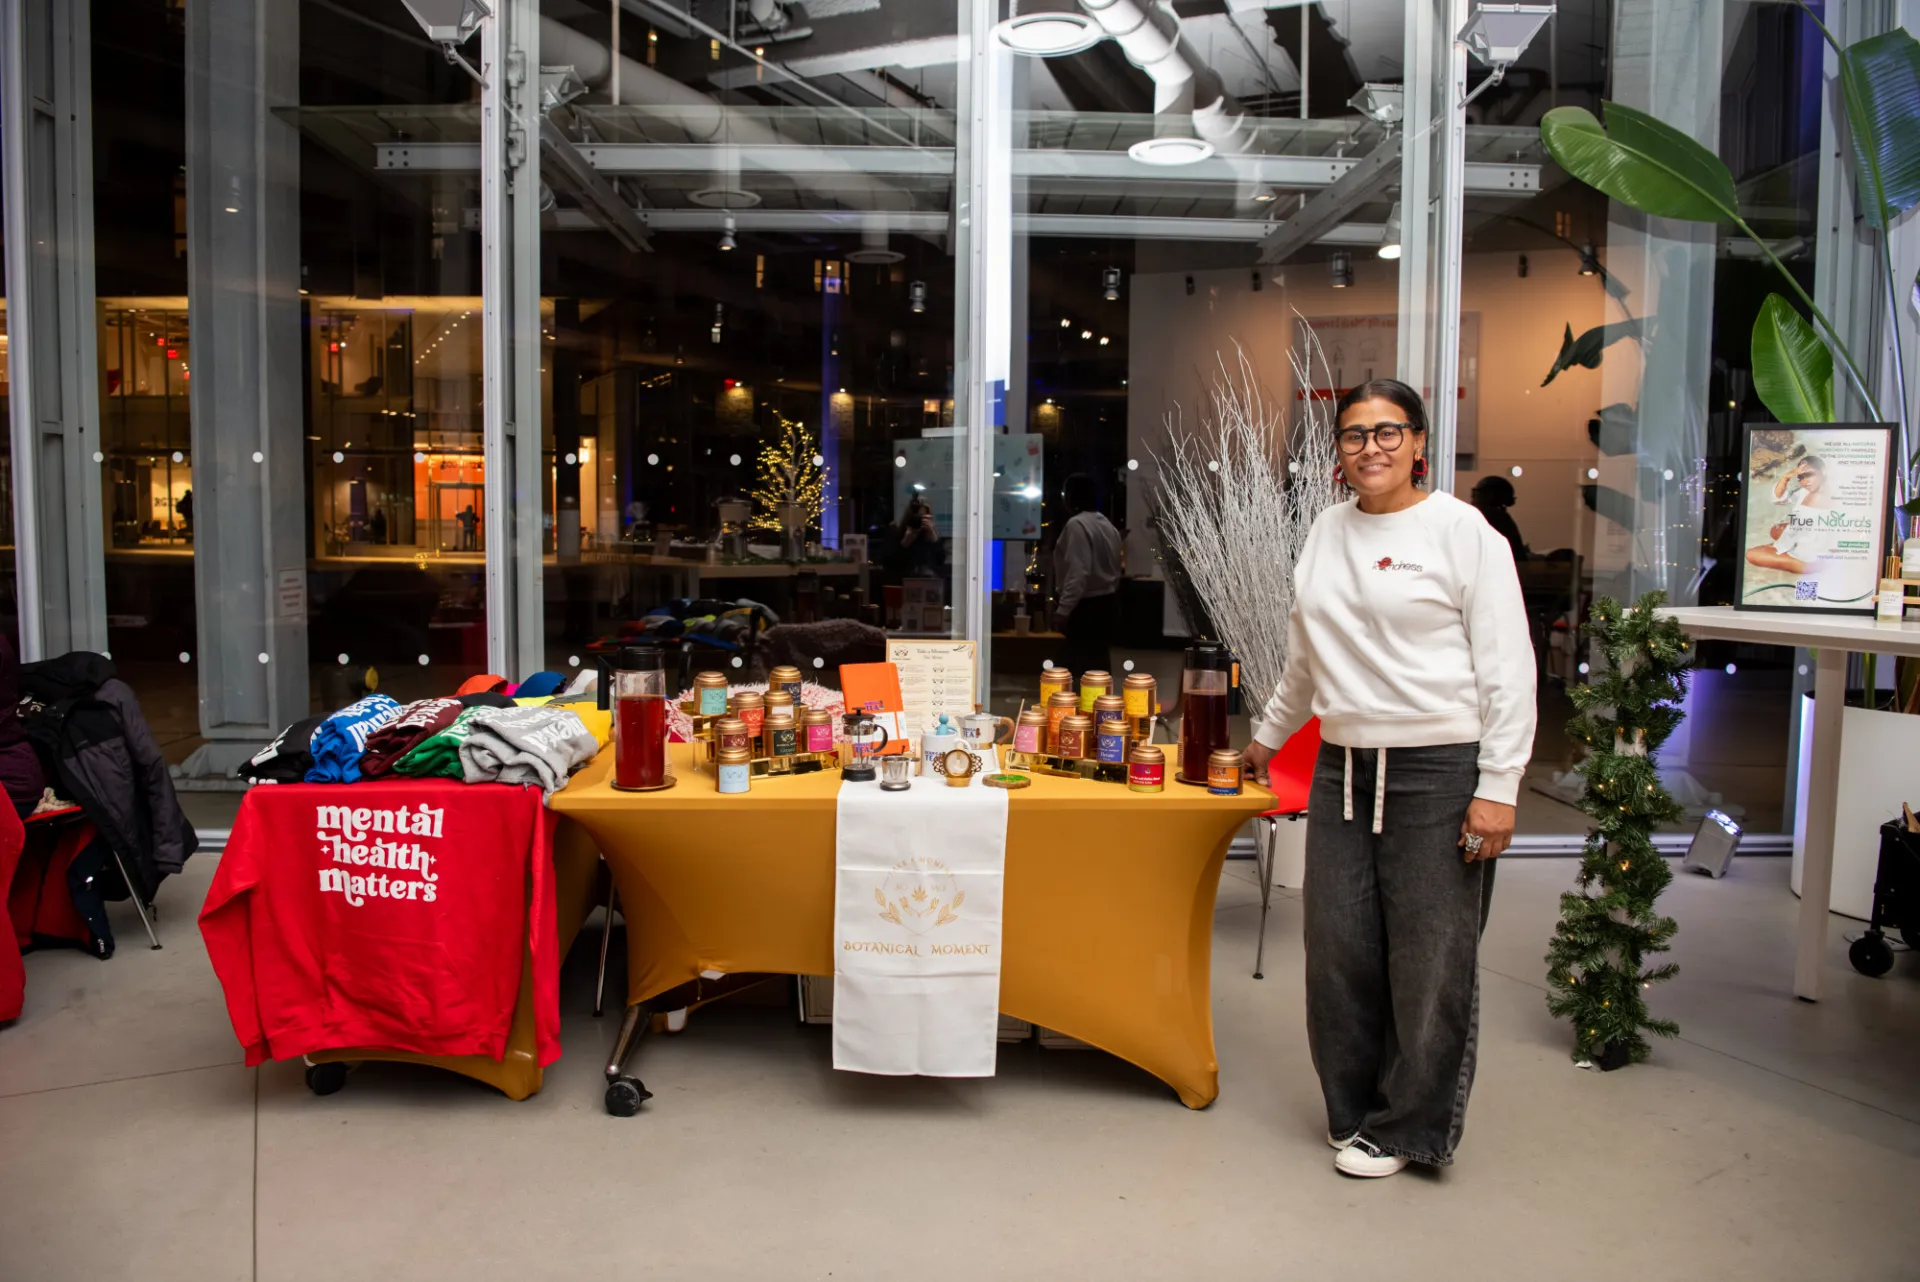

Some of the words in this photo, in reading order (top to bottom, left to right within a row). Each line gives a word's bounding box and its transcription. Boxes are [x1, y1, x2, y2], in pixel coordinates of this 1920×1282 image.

[1788, 514, 1814, 527] True
[316, 803, 444, 841] mental
[317, 831, 438, 882] health
[318, 868, 437, 907] matters
[843, 940, 922, 957] BOTANICAL
[931, 943, 991, 957] MOMENT
